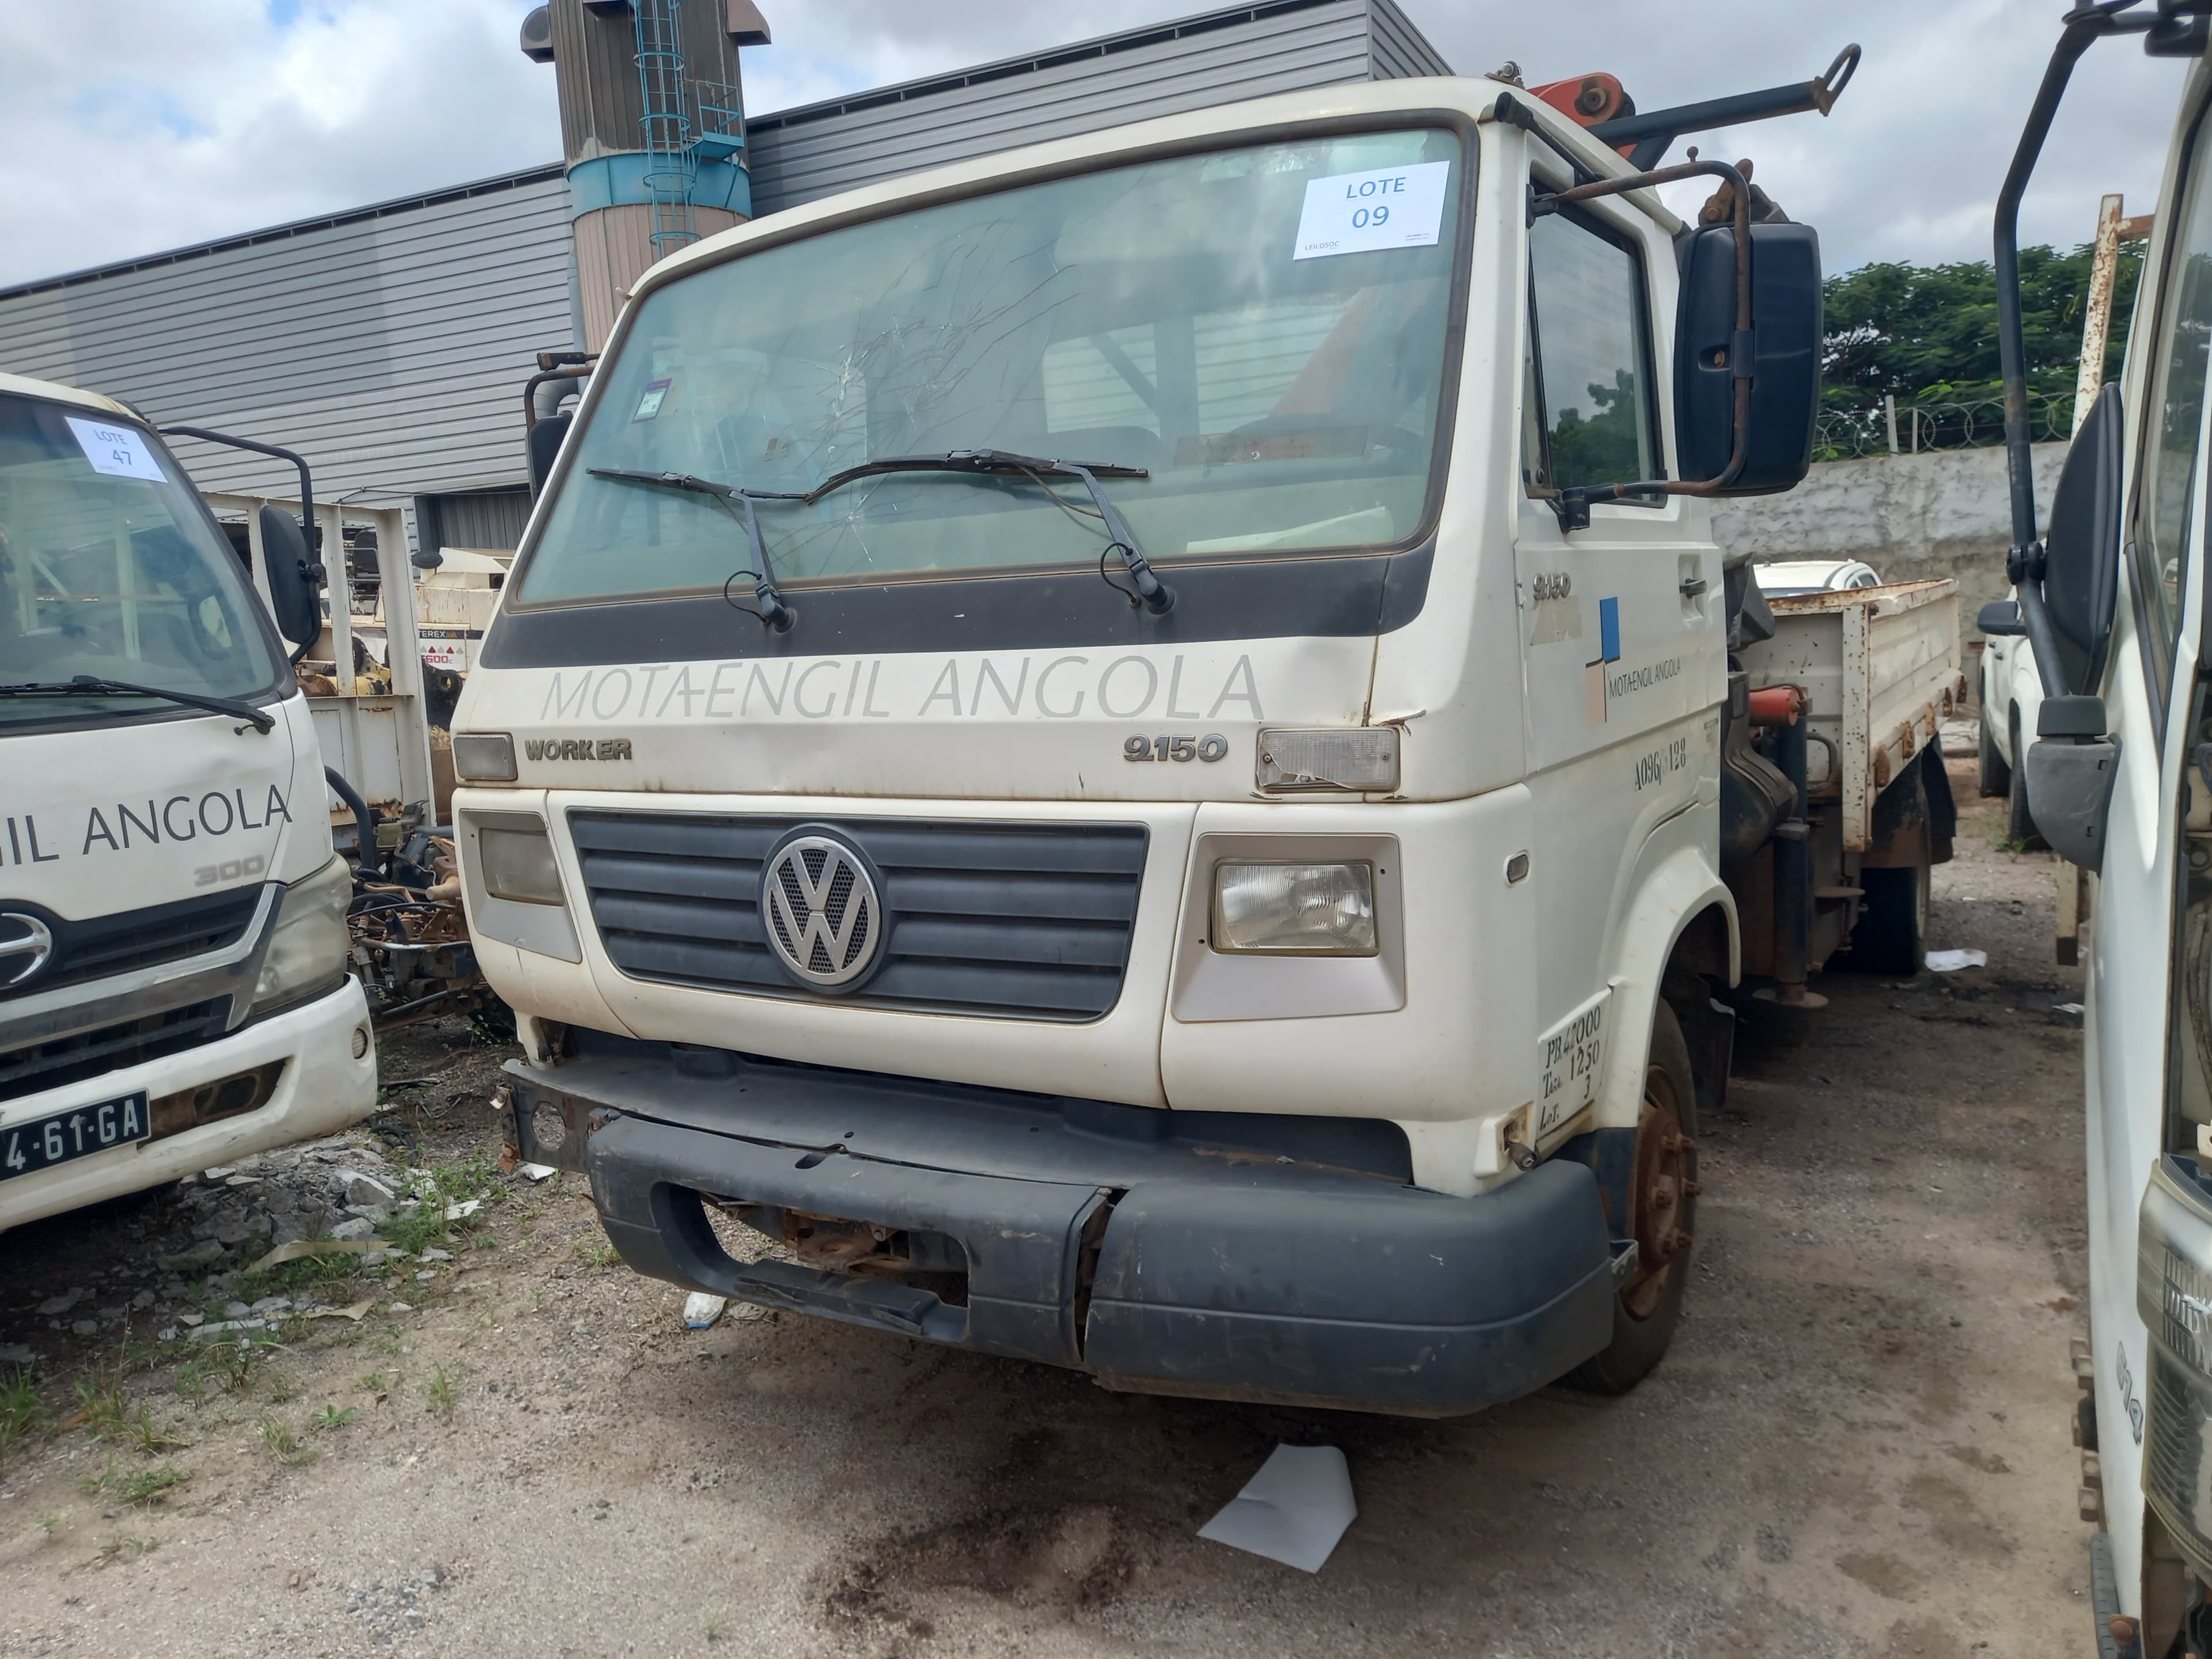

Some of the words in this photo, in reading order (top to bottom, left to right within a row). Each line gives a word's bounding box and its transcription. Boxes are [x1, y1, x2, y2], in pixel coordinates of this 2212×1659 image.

[1346, 176, 1406, 199] LOTE
[1351, 206, 1389, 229] 09
[93, 430, 128, 445] LOTE
[112, 449, 132, 465] 47
[1655, 657, 1681, 683] ANGOLA
[917, 654, 1264, 721] ANGOLA
[524, 737, 632, 762] WORKER
[1123, 733, 1228, 763] 9150
[0, 815, 59, 866] IL
[82, 783, 293, 855] ANGOLA
[193, 854, 265, 887] 300
[1570, 1039, 1600, 1081] 1250
[1584, 1073, 1591, 1100] 3
